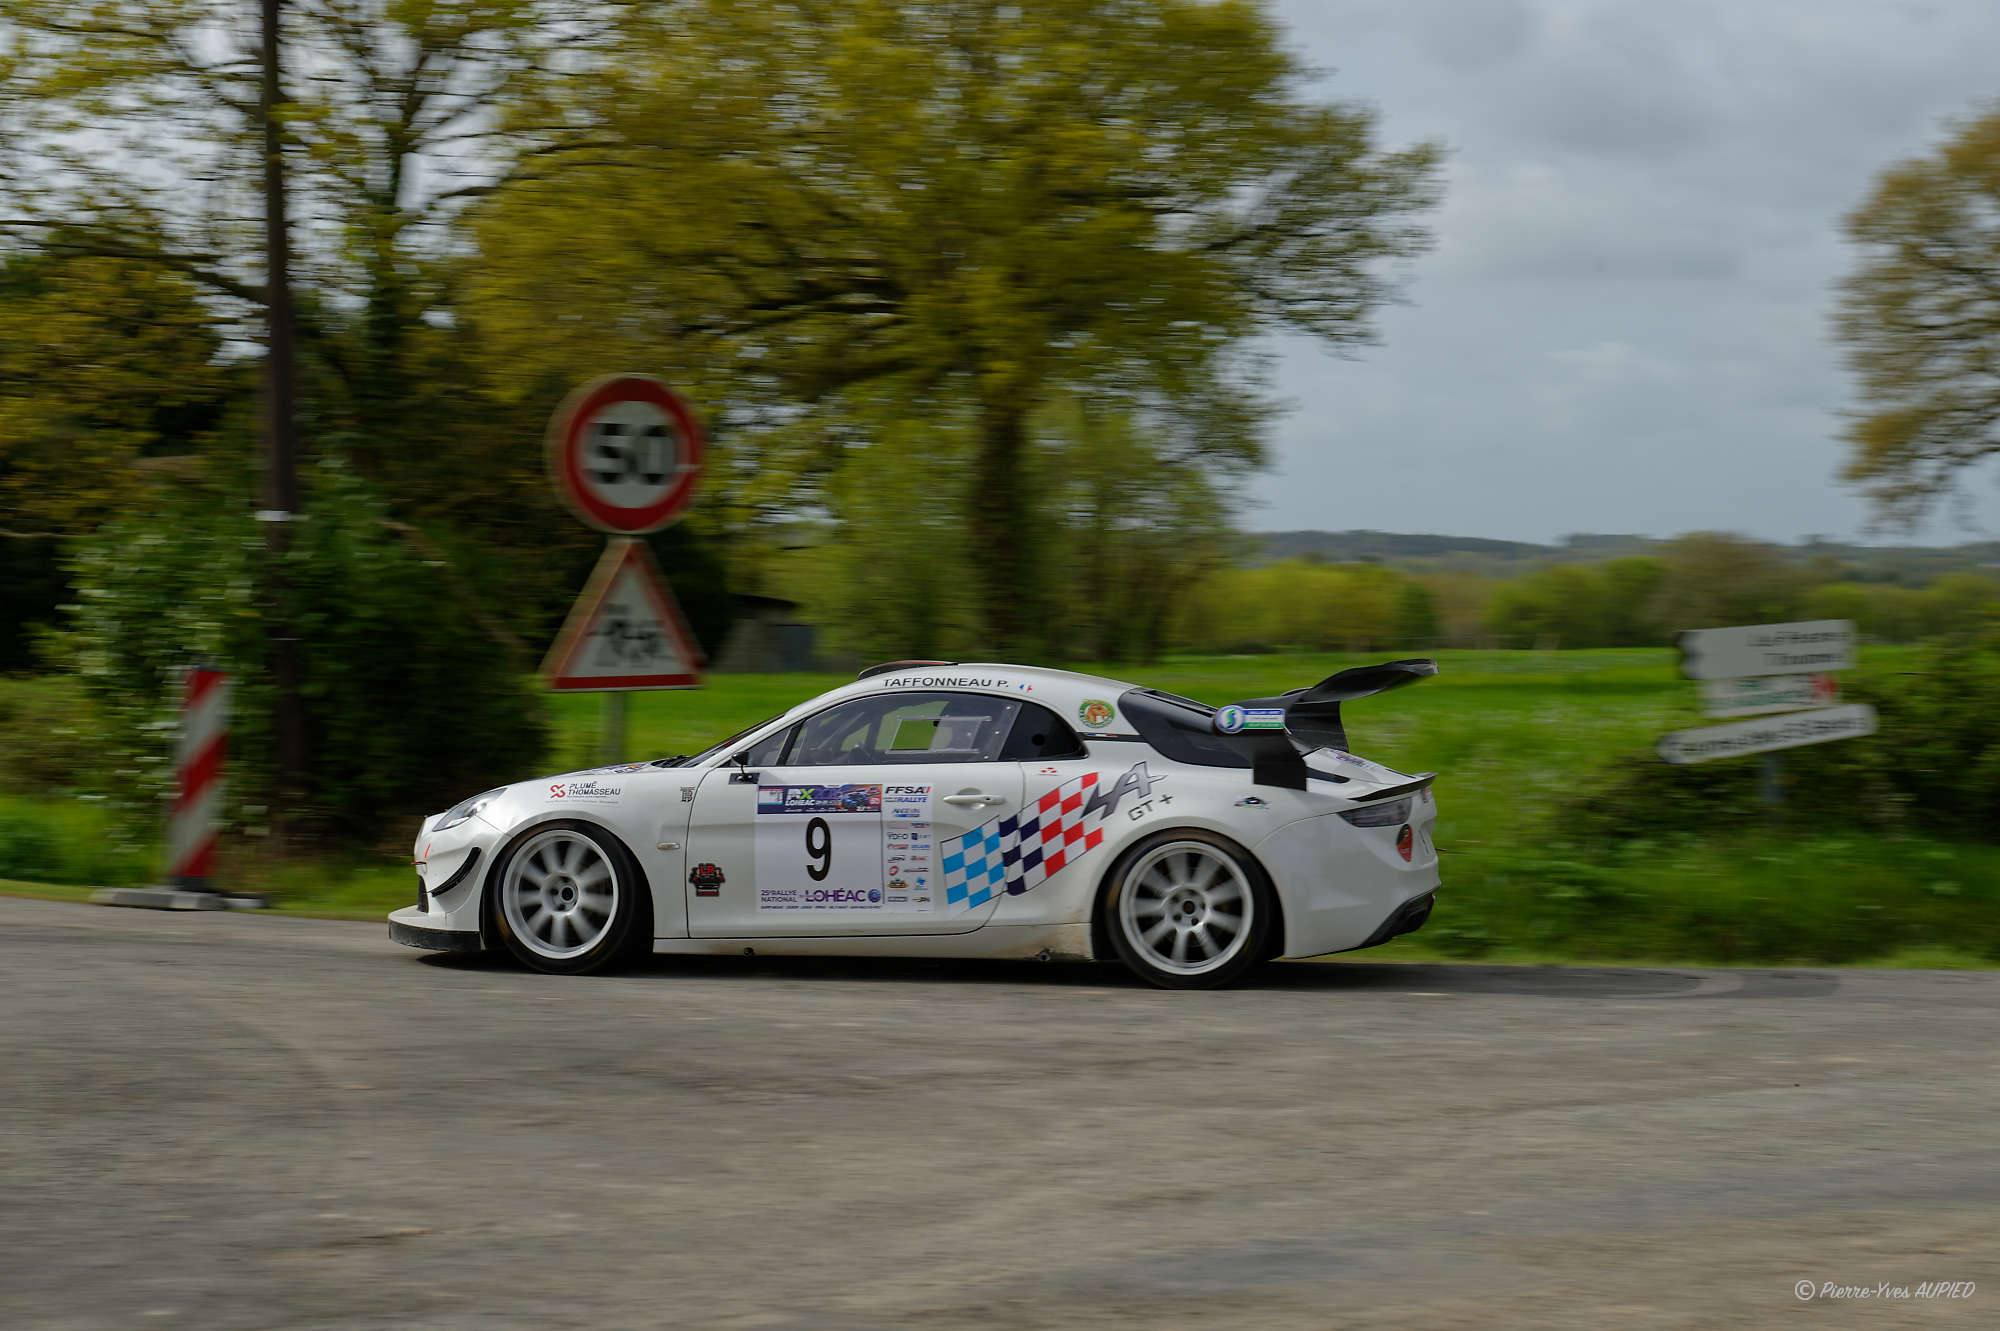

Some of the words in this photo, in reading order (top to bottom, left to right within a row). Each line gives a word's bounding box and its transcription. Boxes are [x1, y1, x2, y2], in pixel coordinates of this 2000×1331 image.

[587, 423, 674, 486] 50
[884, 677, 992, 687] TAFFONNEAU
[997, 680, 1009, 688] P.
[568, 788, 621, 796] THOMASSEAU
[885, 786, 926, 794] FFSA
[1127, 800, 1153, 821] GT
[805, 816, 832, 882] 9
[805, 887, 866, 903] LOHÉAC
